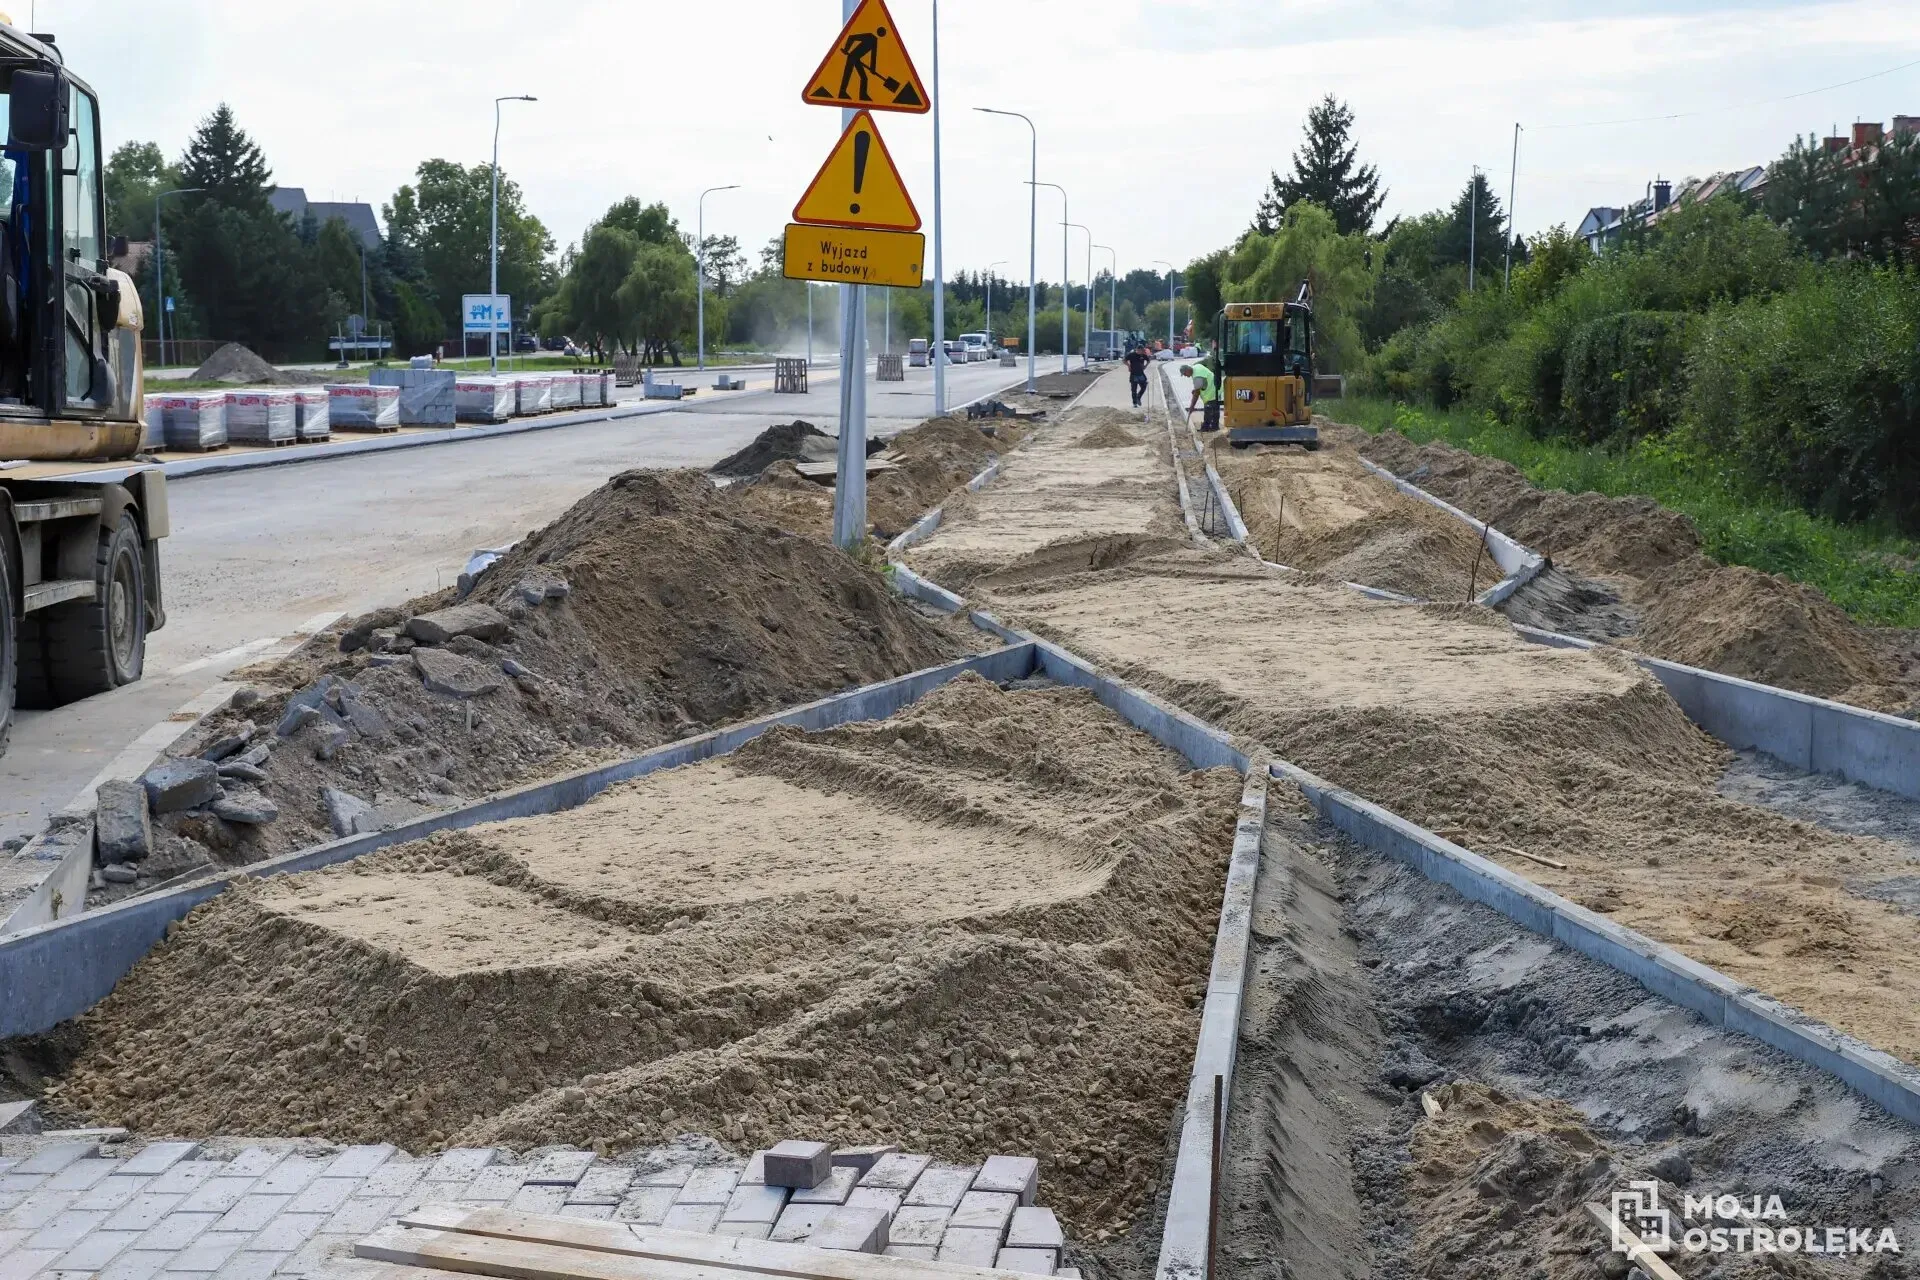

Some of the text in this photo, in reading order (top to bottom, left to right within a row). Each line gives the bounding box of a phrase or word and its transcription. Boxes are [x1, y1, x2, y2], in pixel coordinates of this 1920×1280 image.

[820, 241, 868, 260] Wyjazd
[807, 260, 869, 279] z budowy
[1236, 389, 1251, 400] CAT
